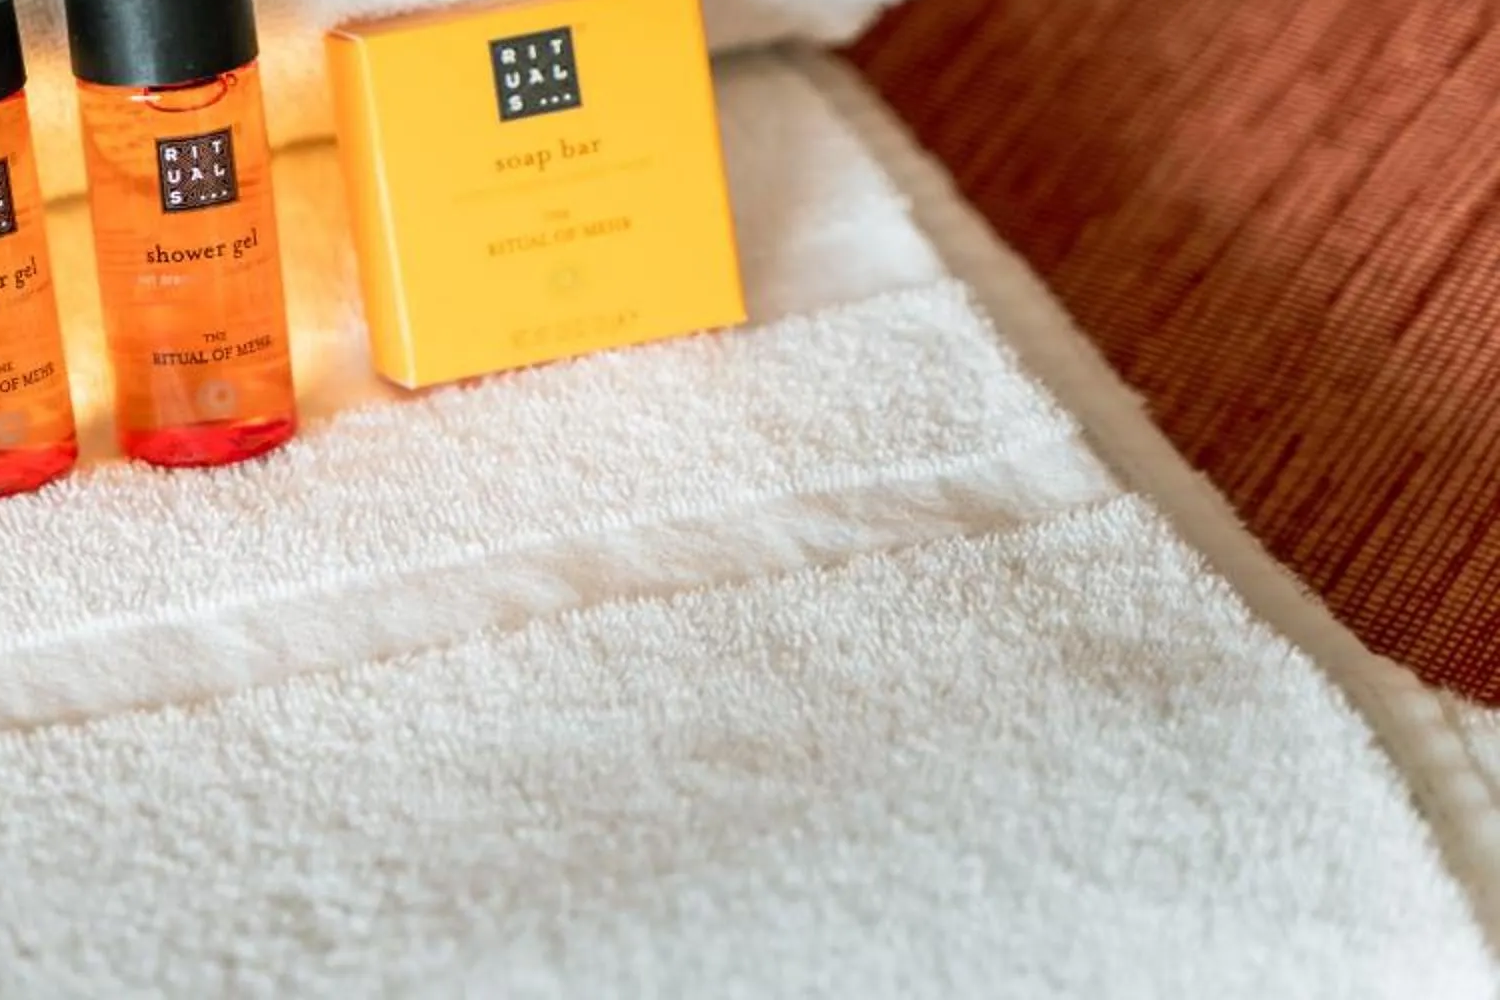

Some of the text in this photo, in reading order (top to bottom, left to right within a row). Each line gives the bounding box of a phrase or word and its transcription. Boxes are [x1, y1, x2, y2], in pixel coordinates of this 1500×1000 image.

[494, 137, 603, 173] soap bar
[147, 227, 258, 264] shower gel
[14, 255, 37, 288] gel
[152, 351, 209, 366] RITUAL
[211, 346, 233, 361] OF
[0, 377, 20, 393] OF
